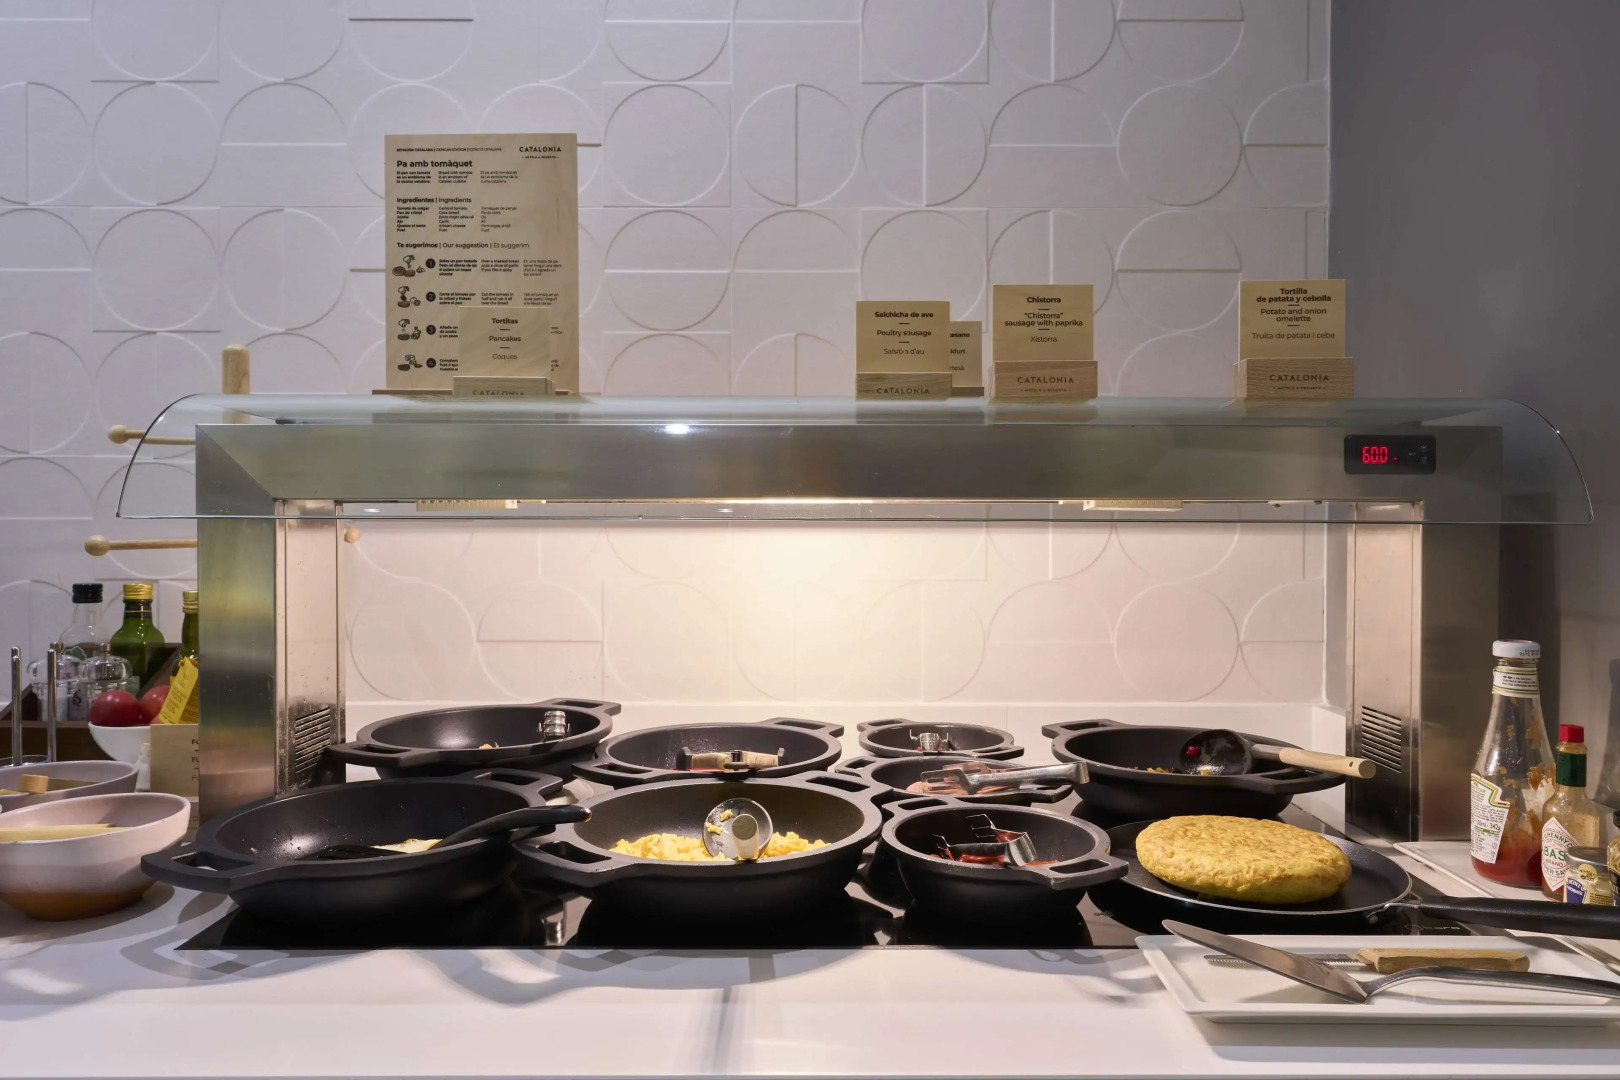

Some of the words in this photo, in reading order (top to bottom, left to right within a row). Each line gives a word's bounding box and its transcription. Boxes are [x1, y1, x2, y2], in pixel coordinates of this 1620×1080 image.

[431, 160, 472, 169] tomàquet
[1055, 319, 1083, 328] paprika
[1362, 446, 1388, 463] 60.0
[1490, 822, 1501, 833] 342g
[1543, 846, 1566, 861] BAS
